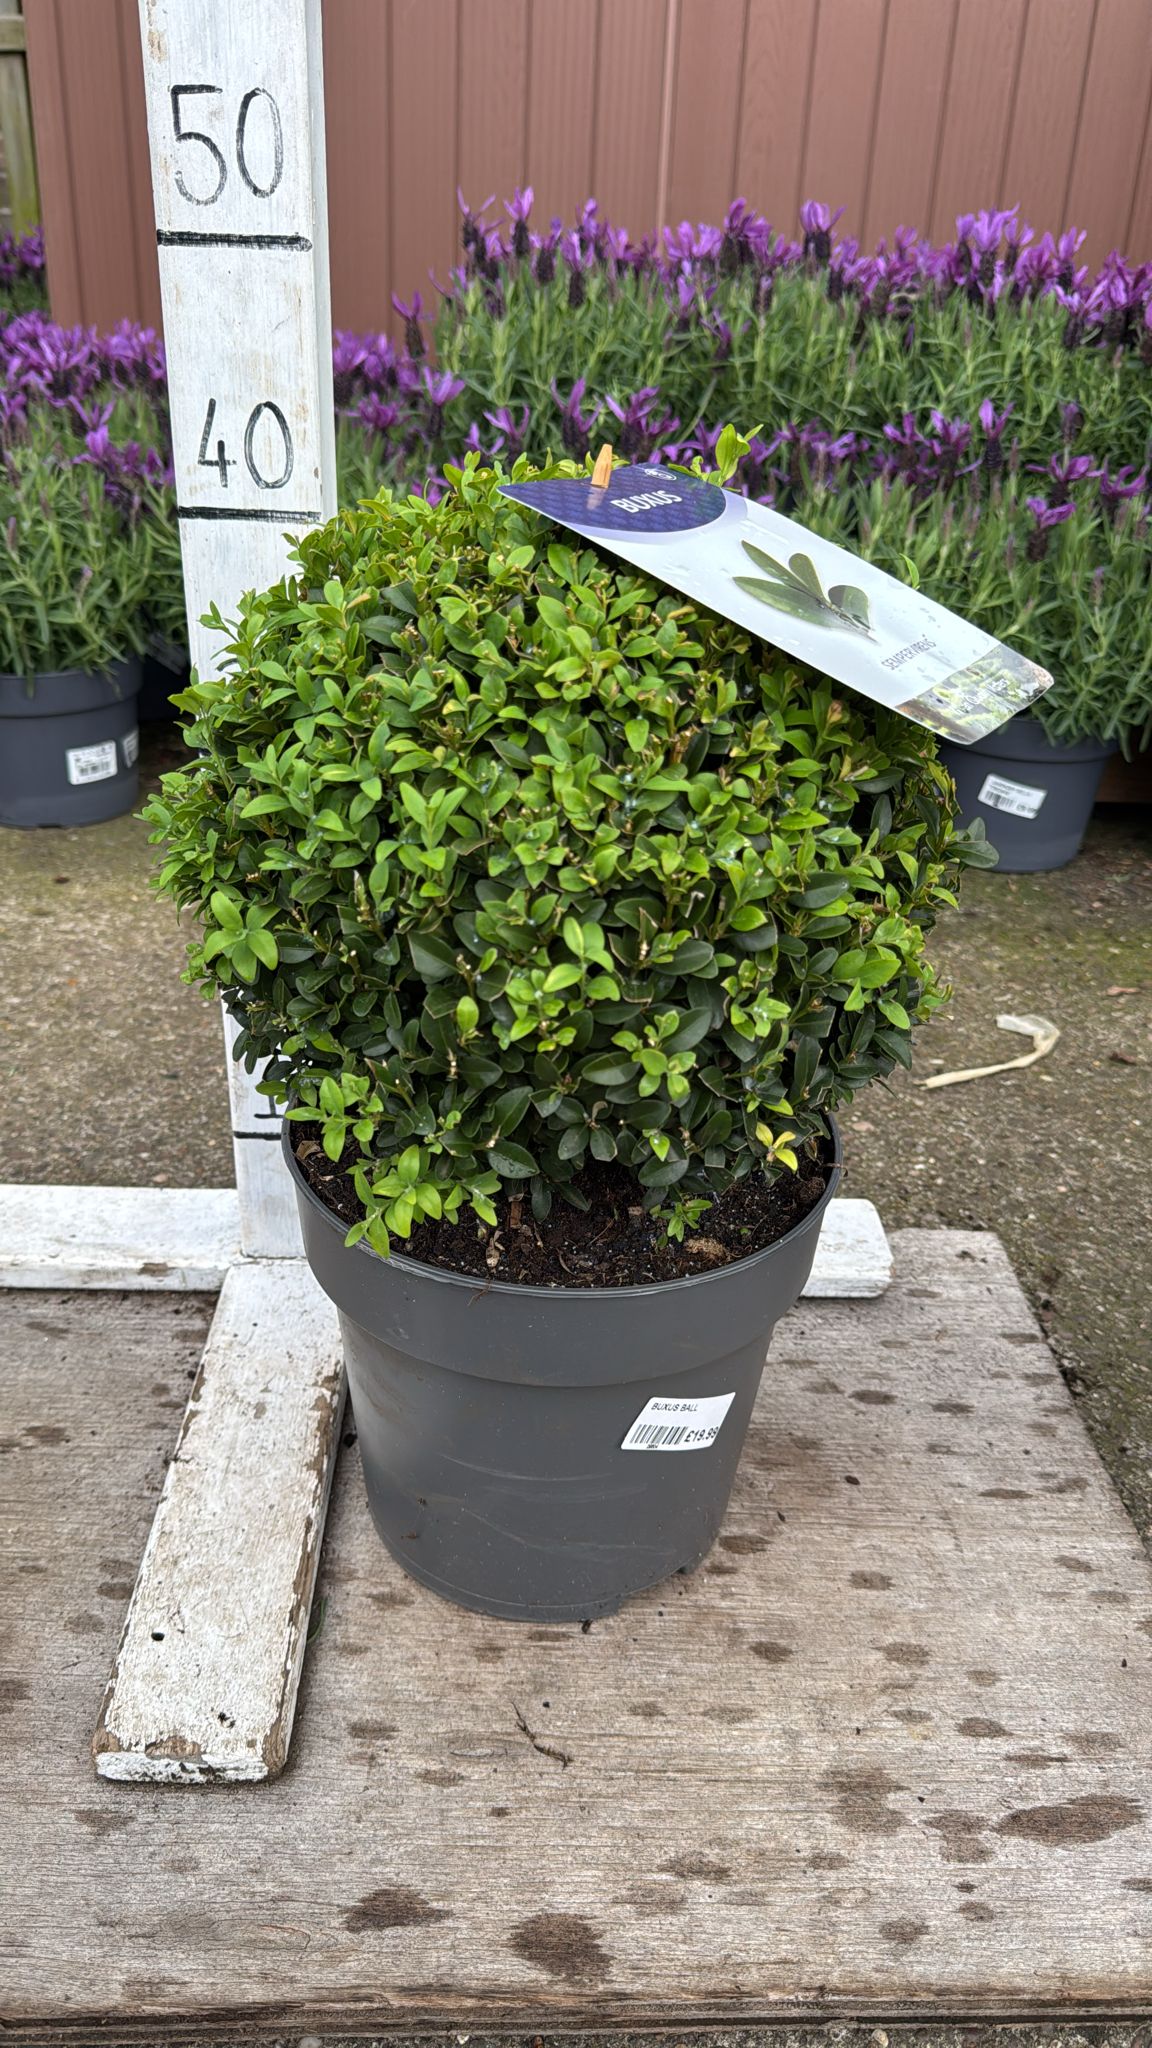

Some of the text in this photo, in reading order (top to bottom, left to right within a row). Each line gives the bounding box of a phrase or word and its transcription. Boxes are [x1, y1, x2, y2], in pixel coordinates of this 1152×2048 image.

[170, 84, 284, 206] 50
[197, 397, 294, 490] 40
[610, 490, 683, 513] BUXUS
[651, 1402, 698, 1412] BUXUS BALL
[684, 1426, 718, 1442] £19.99
